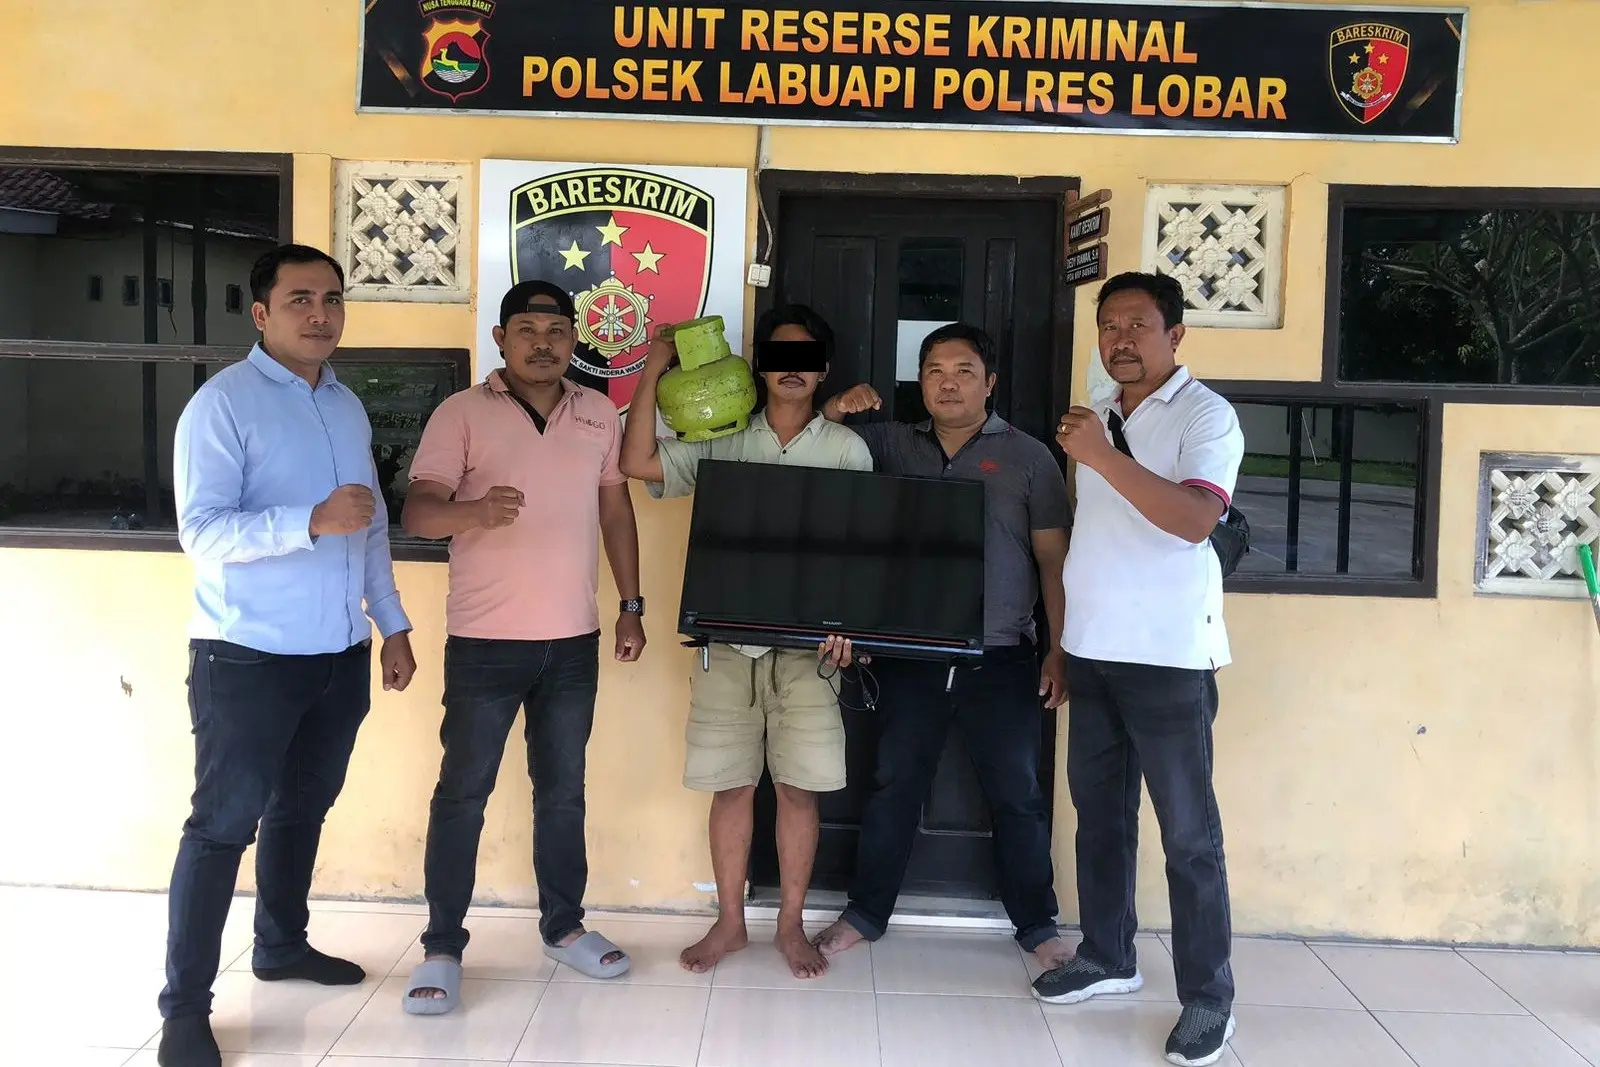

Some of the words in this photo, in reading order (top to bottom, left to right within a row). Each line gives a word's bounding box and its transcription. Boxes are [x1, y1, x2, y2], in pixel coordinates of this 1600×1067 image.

[422, 1, 440, 12] NUSA
[471, 0, 492, 12] BARAT
[613, 6, 725, 49] UNIT
[741, 9, 951, 57] RESERSE
[967, 14, 1198, 65] KRIMINAL
[1336, 25, 1405, 43] BARESKRIM
[521, 55, 704, 103] POLSEK
[718, 60, 914, 109] LABUAPI
[933, 67, 1115, 116] POLRES
[1131, 74, 1287, 121] LOBAR
[526, 176, 699, 221] BARESKRIM
[578, 361, 598, 375] SAKTI
